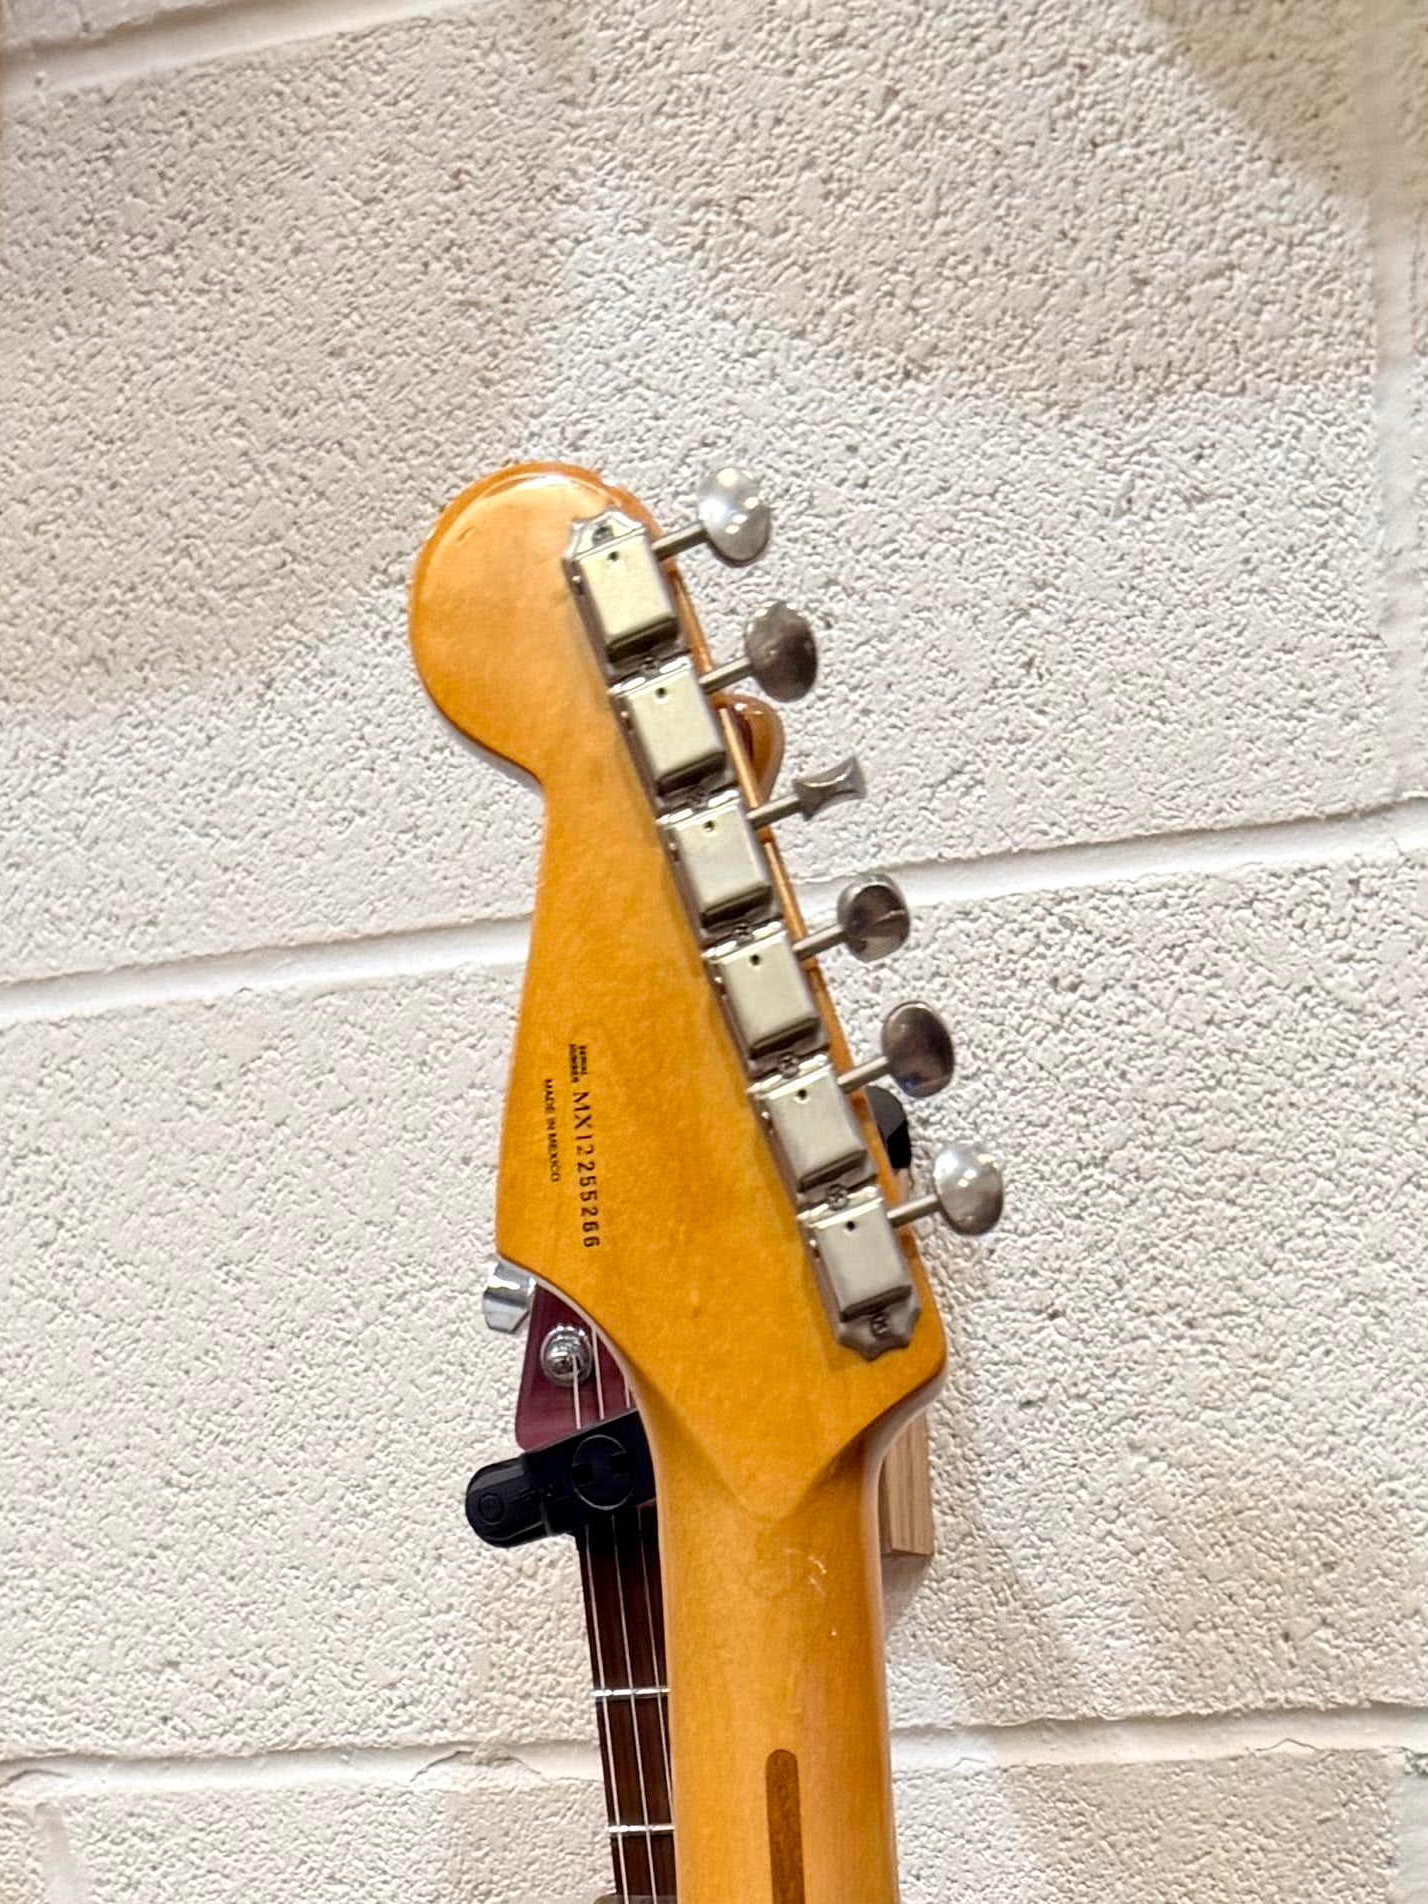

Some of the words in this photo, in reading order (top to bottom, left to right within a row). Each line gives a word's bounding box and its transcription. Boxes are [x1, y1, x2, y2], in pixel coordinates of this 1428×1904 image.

[542, 1079, 556, 1114] MADE
[545, 1117, 556, 1130] IN
[547, 1132, 562, 1183] MEXICO
[571, 1091, 601, 1248] MX12255266
